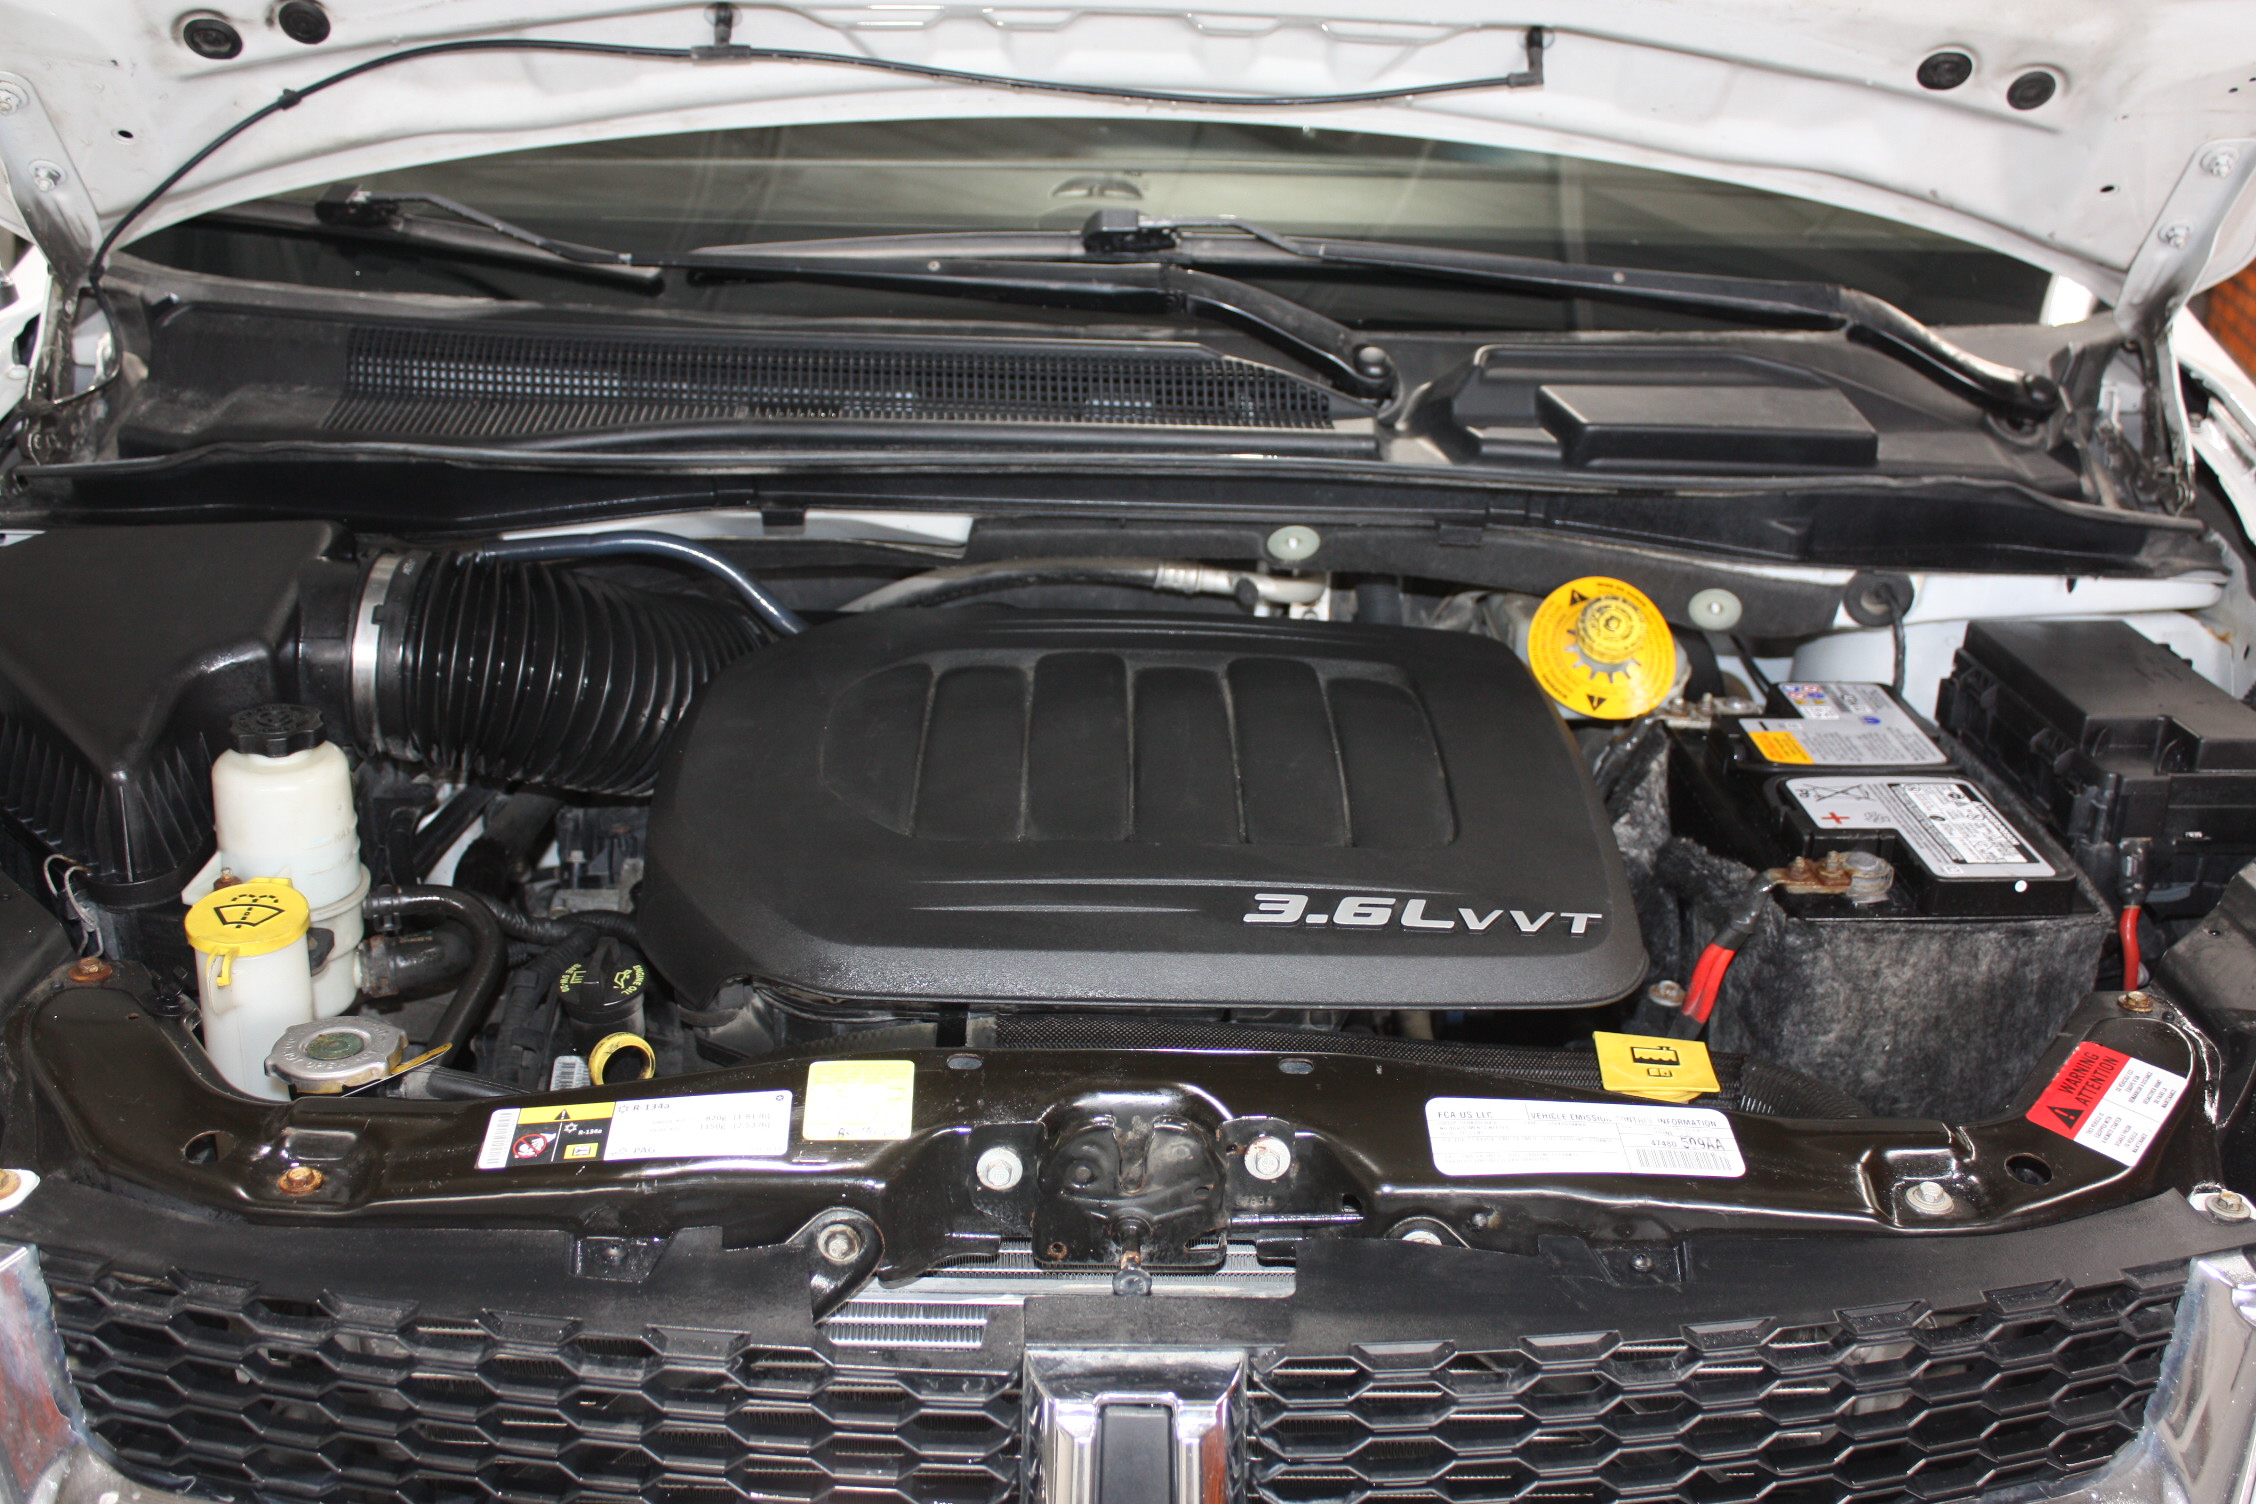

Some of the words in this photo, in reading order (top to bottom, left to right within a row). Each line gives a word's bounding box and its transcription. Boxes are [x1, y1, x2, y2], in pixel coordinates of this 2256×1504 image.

[632, 964, 646, 987] ENGINE
[621, 984, 639, 996] OIL
[2058, 1052, 2100, 1095] WARNING
[2075, 1056, 2119, 1106] ATTENTION
[633, 1103, 670, 1112] R-134a
[1437, 1111, 1456, 1119] FCA
[1459, 1111, 1473, 1119] US
[1529, 1112, 1567, 1120] VEHICLE
[1657, 1117, 1717, 1127] INFORMATION
[578, 1127, 603, 1136] R-134a
[633, 1146, 656, 1154] PAG
